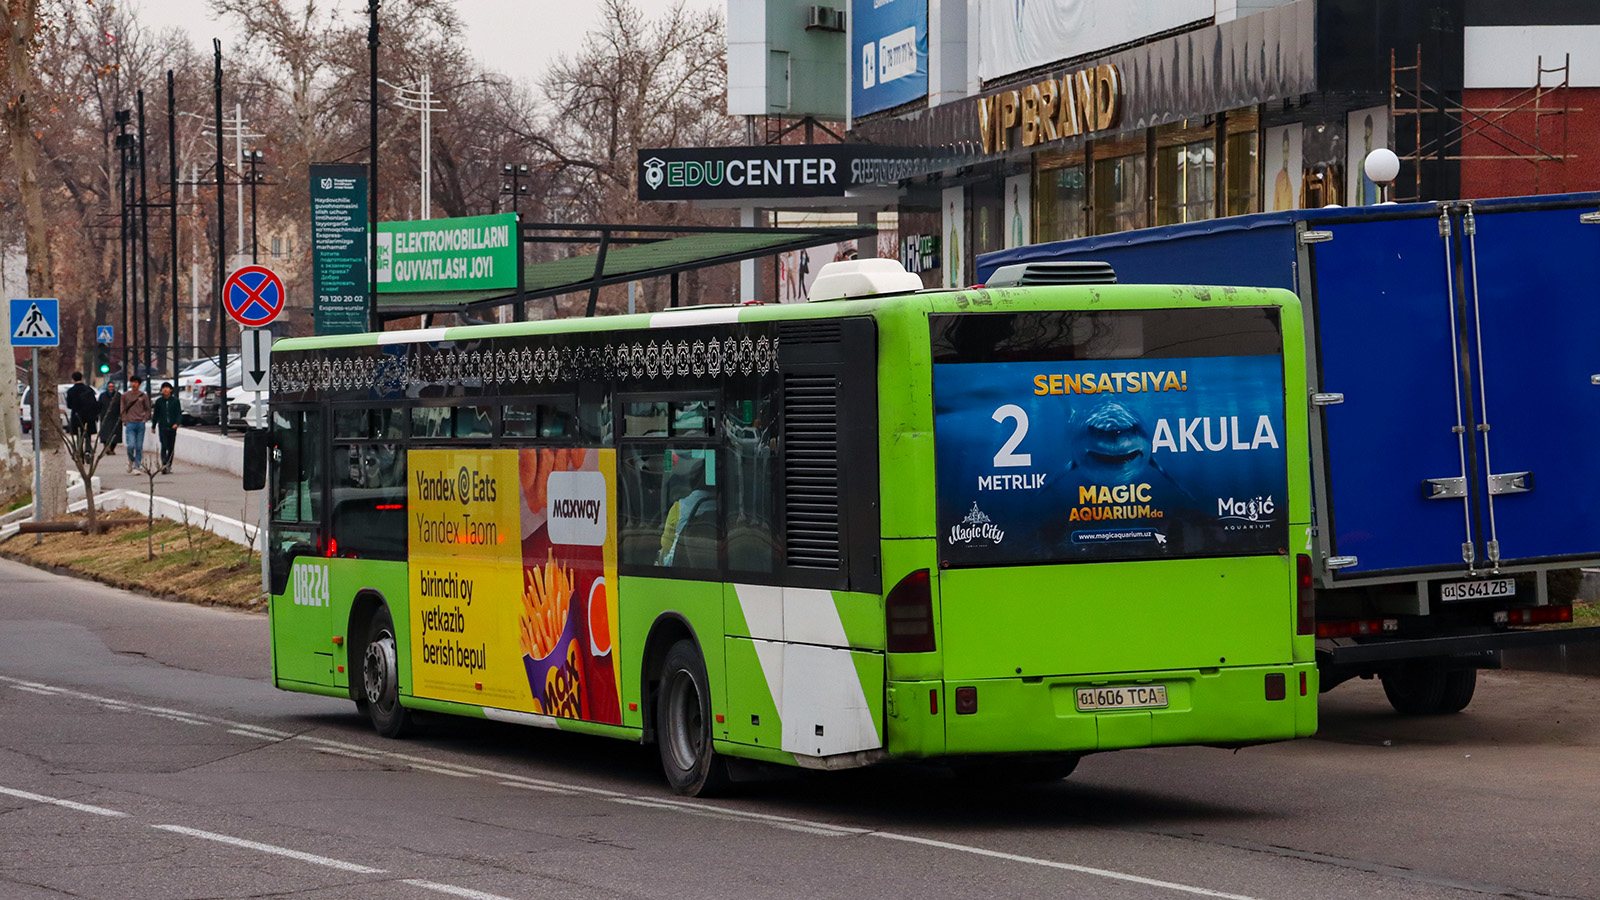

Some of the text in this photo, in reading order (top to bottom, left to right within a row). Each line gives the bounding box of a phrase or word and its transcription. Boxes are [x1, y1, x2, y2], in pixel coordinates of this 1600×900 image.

[977, 63, 1121, 155] VIP BRAND
[667, 158, 837, 187] EDUCENTER
[395, 225, 509, 254] ELEKTROMOBILLARNI
[395, 257, 467, 281] QUVVATLASH
[469, 256, 494, 279] JOYI
[1033, 370, 1188, 396] SENSATSIYA!
[991, 404, 1032, 467] 2
[1152, 415, 1279, 453] AKULA
[416, 470, 497, 502] Yandex Eats
[978, 473, 1047, 491] METRLIK
[1079, 483, 1152, 504] MAGIC
[1218, 494, 1275, 521] Magic
[416, 512, 497, 545] Yandex Taom
[948, 523, 1005, 545] Magic City
[1079, 531, 1152, 541] www.magicaquarium.uz
[293, 563, 329, 607] 08224
[420, 569, 473, 606] birinchi oy
[421, 605, 465, 636] yetkazib
[423, 637, 486, 675] berish bepul
[1081, 689, 1158, 706] 01 606 TCA
